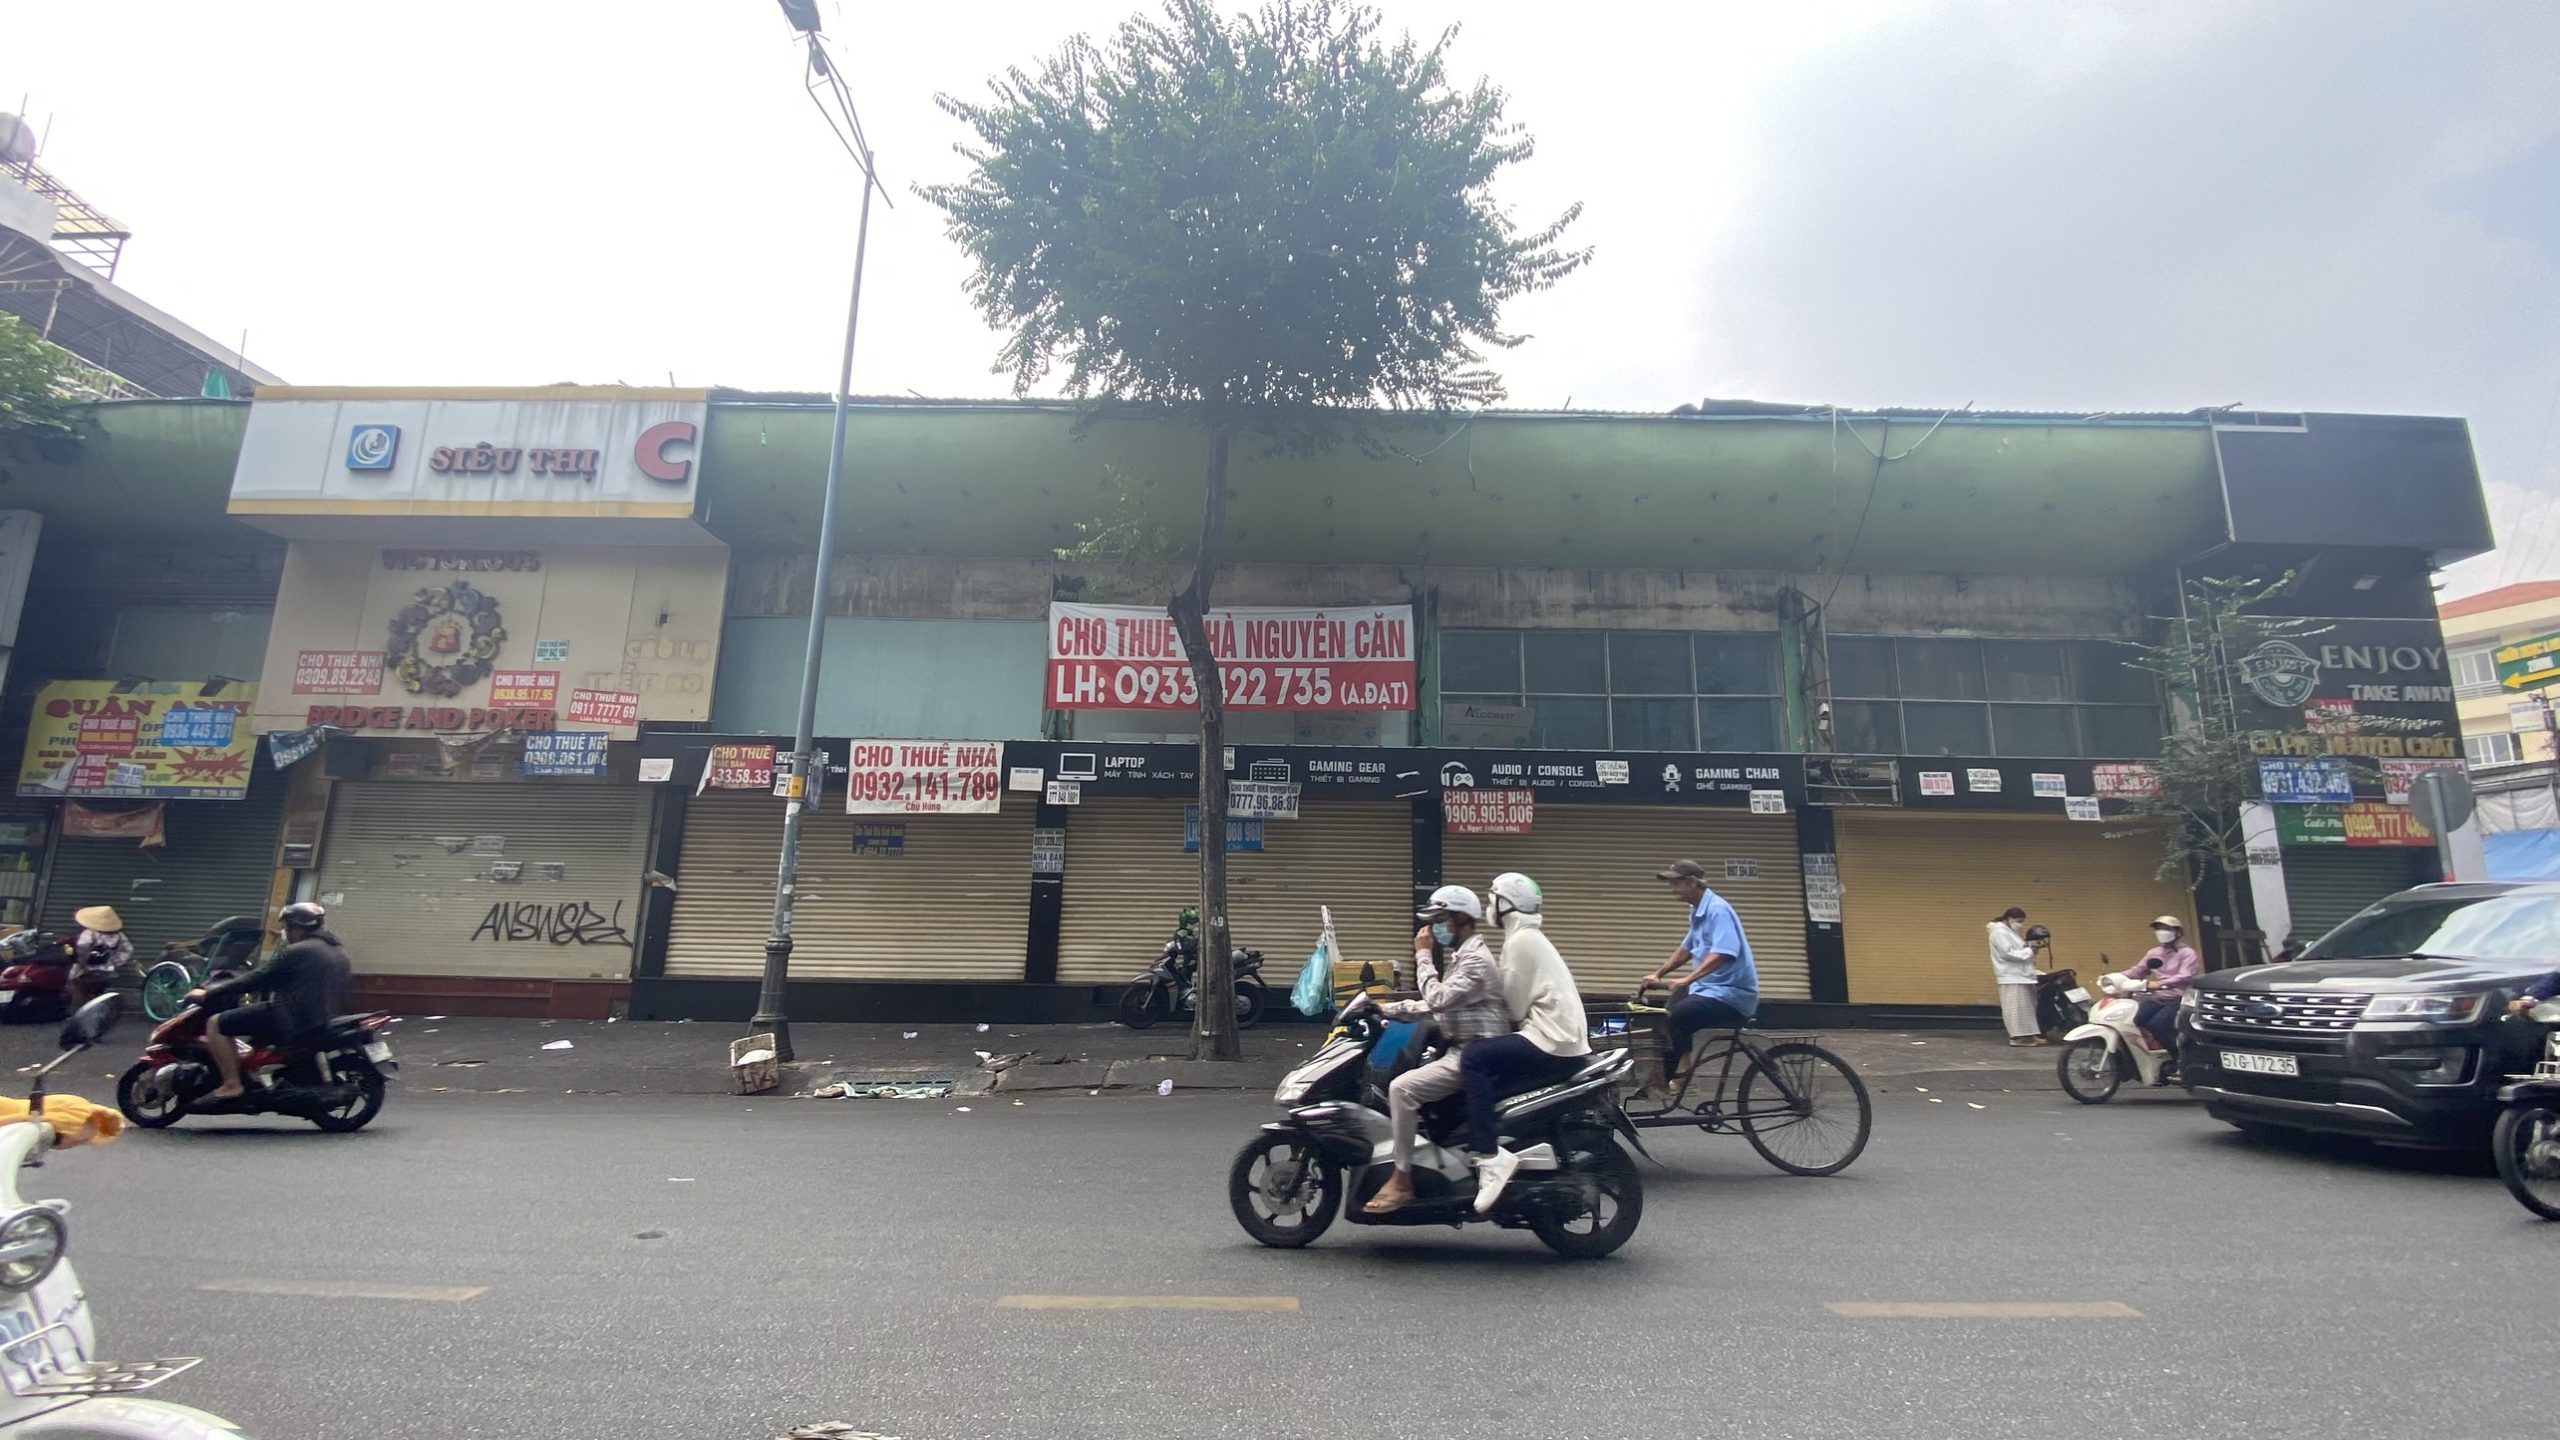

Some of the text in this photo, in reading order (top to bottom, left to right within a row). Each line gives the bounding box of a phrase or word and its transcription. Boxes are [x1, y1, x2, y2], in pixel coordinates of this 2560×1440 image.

[430, 441, 522, 474] SIÊU
[528, 449, 600, 482] THỊ
[1057, 616, 1106, 657] CHO
[1116, 613, 1176, 658] THUÊ
[1246, 612, 1346, 659] NGUYÊN
[1354, 612, 1406, 658] CĂN
[300, 655, 323, 667] CHO
[328, 652, 357, 667] THUÊ
[2320, 645, 2443, 674] ENJOY
[496, 675, 513, 686] CHO
[515, 673, 537, 686] THUÊ
[1057, 665, 1106, 704] LH:
[1275, 667, 1333, 706] 735
[573, 691, 638, 704] CHO THUÊ NHÀ
[2347, 684, 2452, 702] TAKE AWAY
[570, 701, 636, 718] 0911 7777 69
[307, 705, 557, 730] BRIDGE AND POKER
[526, 735, 551, 750] CHO
[556, 733, 585, 750] THUÊ
[713, 747, 737, 759] CHO
[742, 745, 771, 759] THUÊ
[853, 745, 893, 768] CHO
[900, 742, 950, 768] THUÊ
[956, 743, 998, 767] NHÀ
[1104, 757, 1145, 768] LAPTOP
[1309, 760, 1385, 773] GAMING GEAR
[1104, 770, 1121, 778] MÁY
[1128, 770, 1146, 779] TÍNH
[1152, 770, 1175, 779] XÁCH
[1491, 764, 1522, 775] AUDIO
[1538, 765, 1584, 777] CONSOLE
[1696, 768, 1779, 779] GAMING CHAIR
[851, 771, 999, 801] 0932.141.789
[1532, 779, 1555, 787] AUDIO
[1443, 791, 1469, 804] CHO
[1444, 804, 1533, 824] 0906.905.006
[1210, 916, 1223, 927] 49
